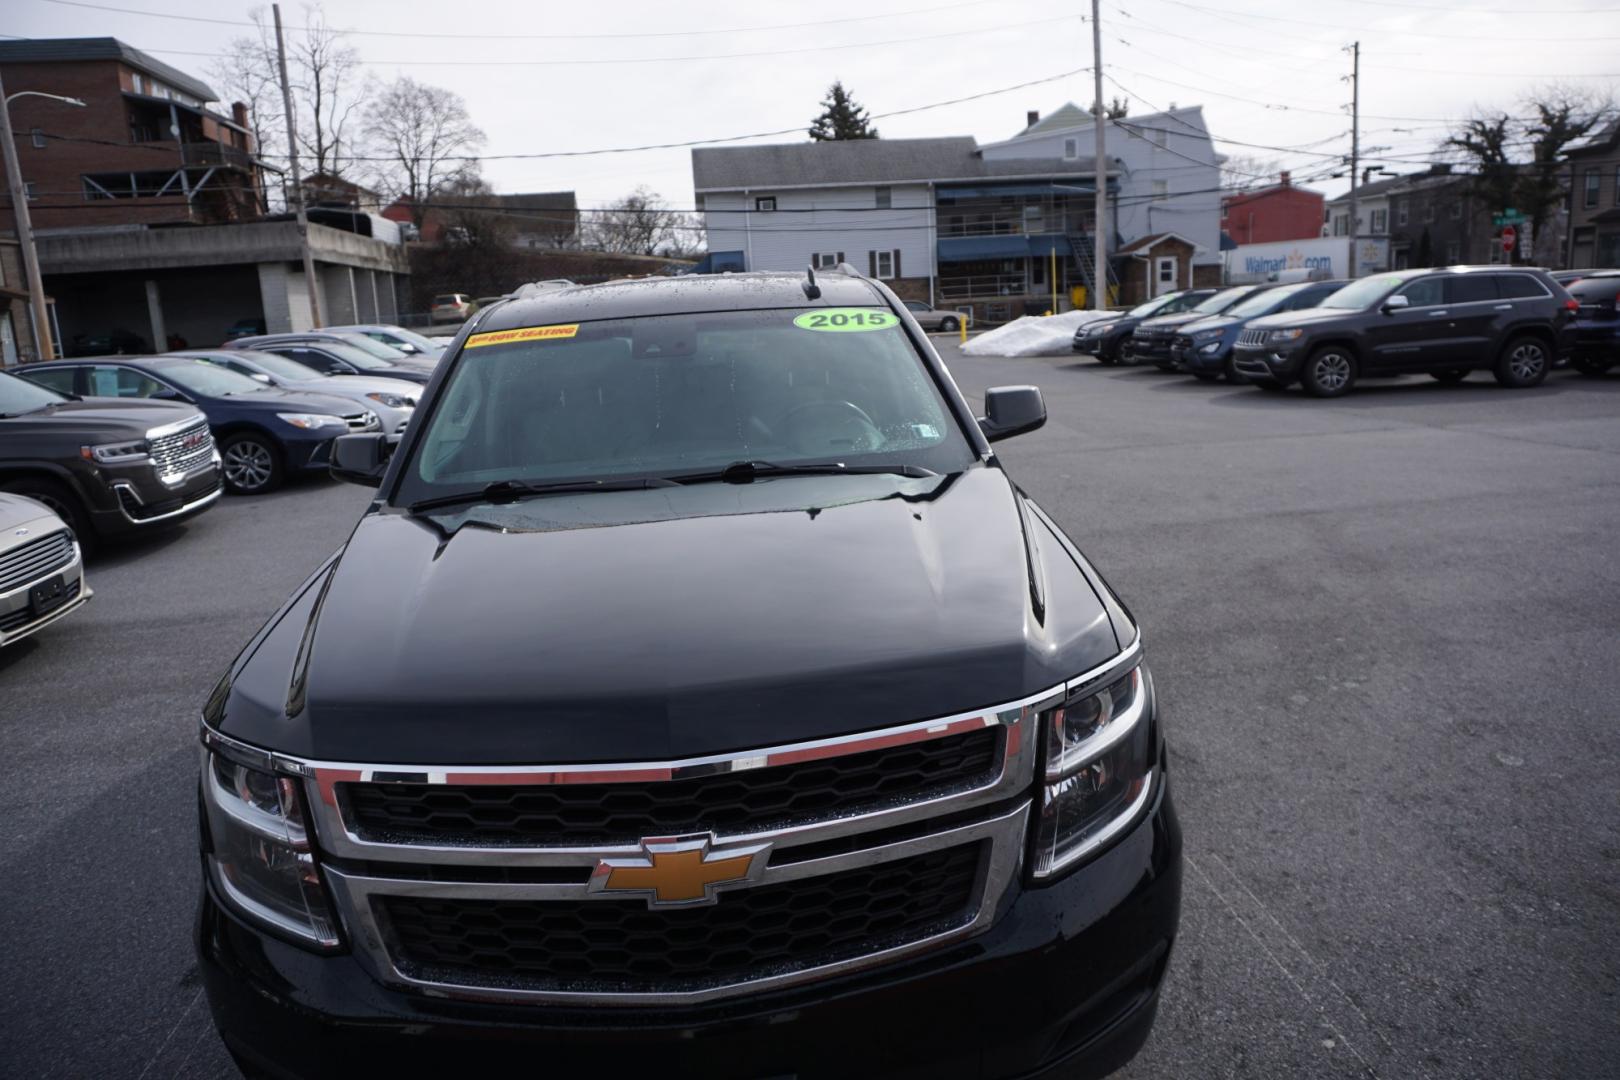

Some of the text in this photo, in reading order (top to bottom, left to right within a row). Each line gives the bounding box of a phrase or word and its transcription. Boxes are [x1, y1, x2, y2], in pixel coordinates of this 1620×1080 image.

[1245, 255, 1287, 273] Walmart
[809, 313, 887, 327] 2015
[488, 331, 517, 342] ROW
[518, 327, 576, 338] SEATING
